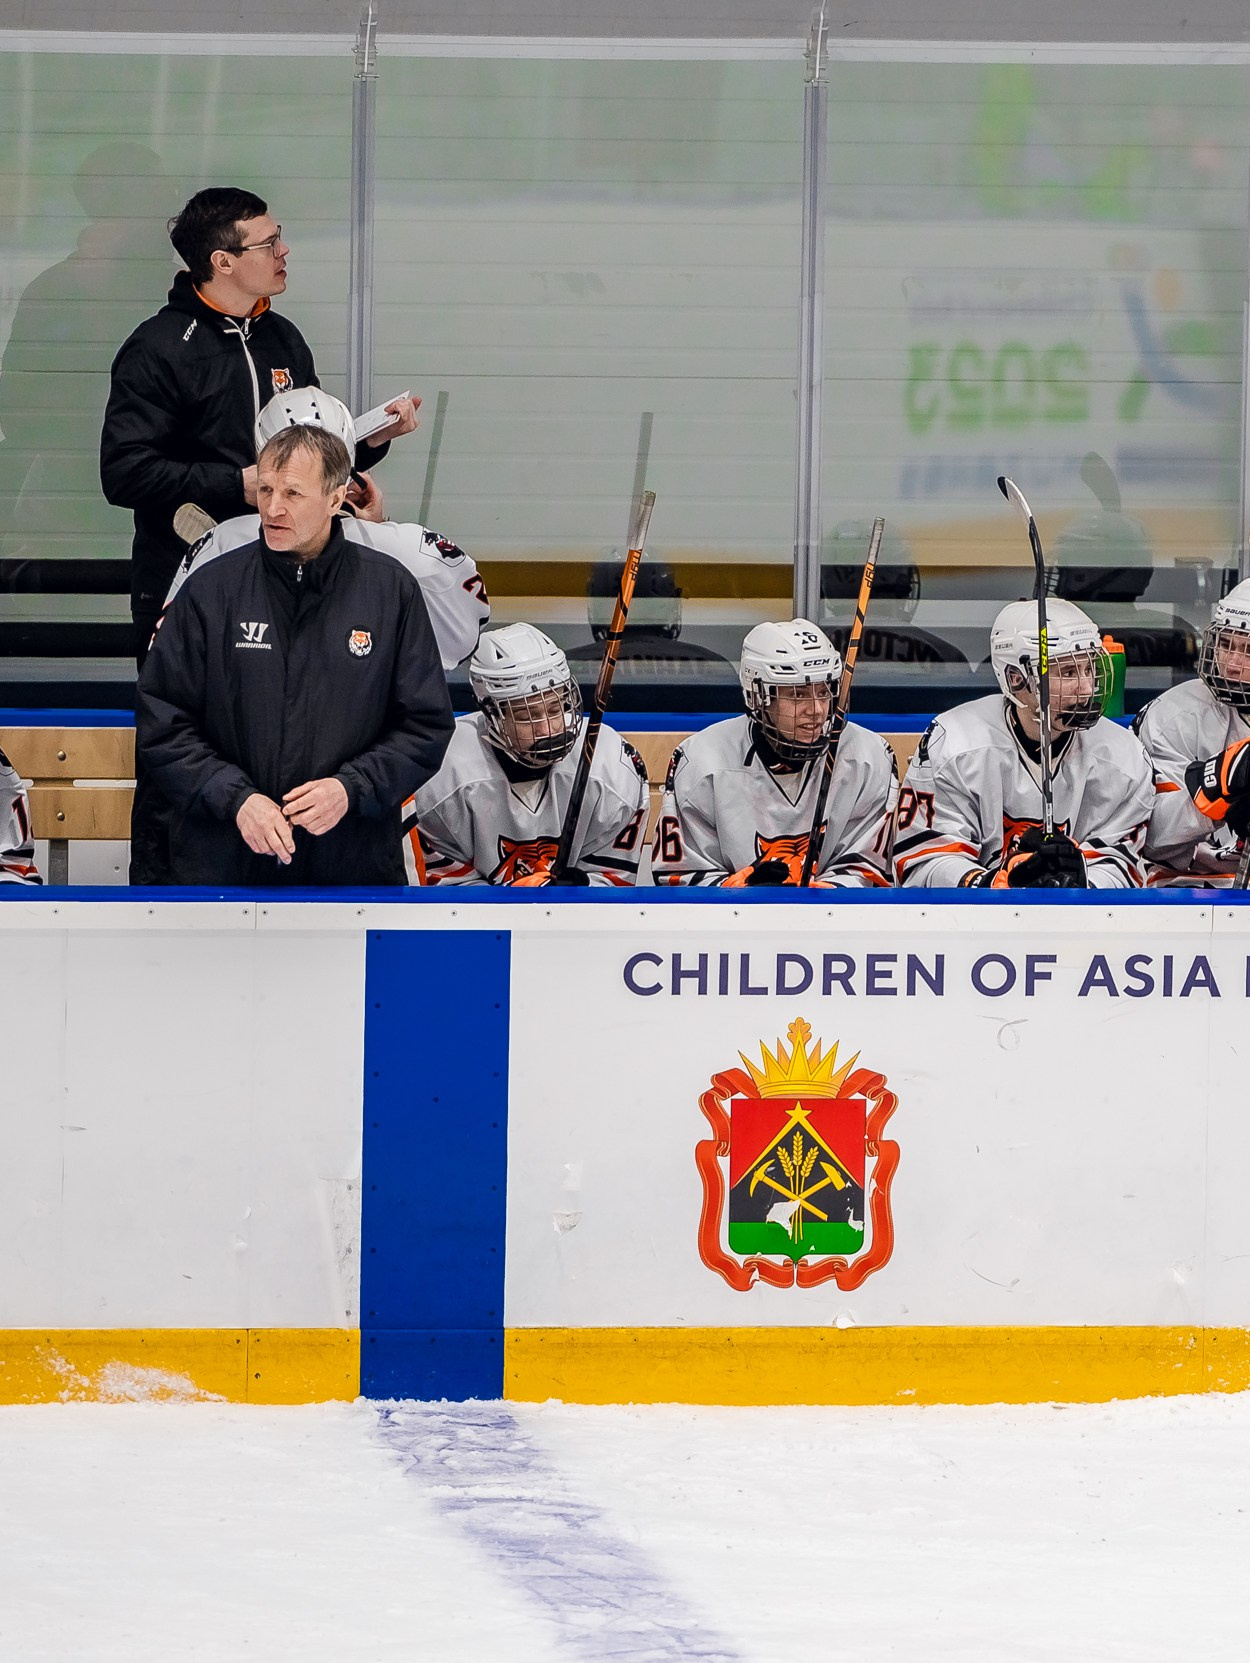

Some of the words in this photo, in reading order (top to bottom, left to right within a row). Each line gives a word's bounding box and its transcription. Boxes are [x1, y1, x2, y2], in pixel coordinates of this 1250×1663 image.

[1224, 606, 1250, 617] BAUER
[802, 657, 832, 668] CCM
[623, 953, 945, 996] CHILDREN
[971, 954, 1057, 997] OF
[1079, 955, 1220, 997] ASIA
